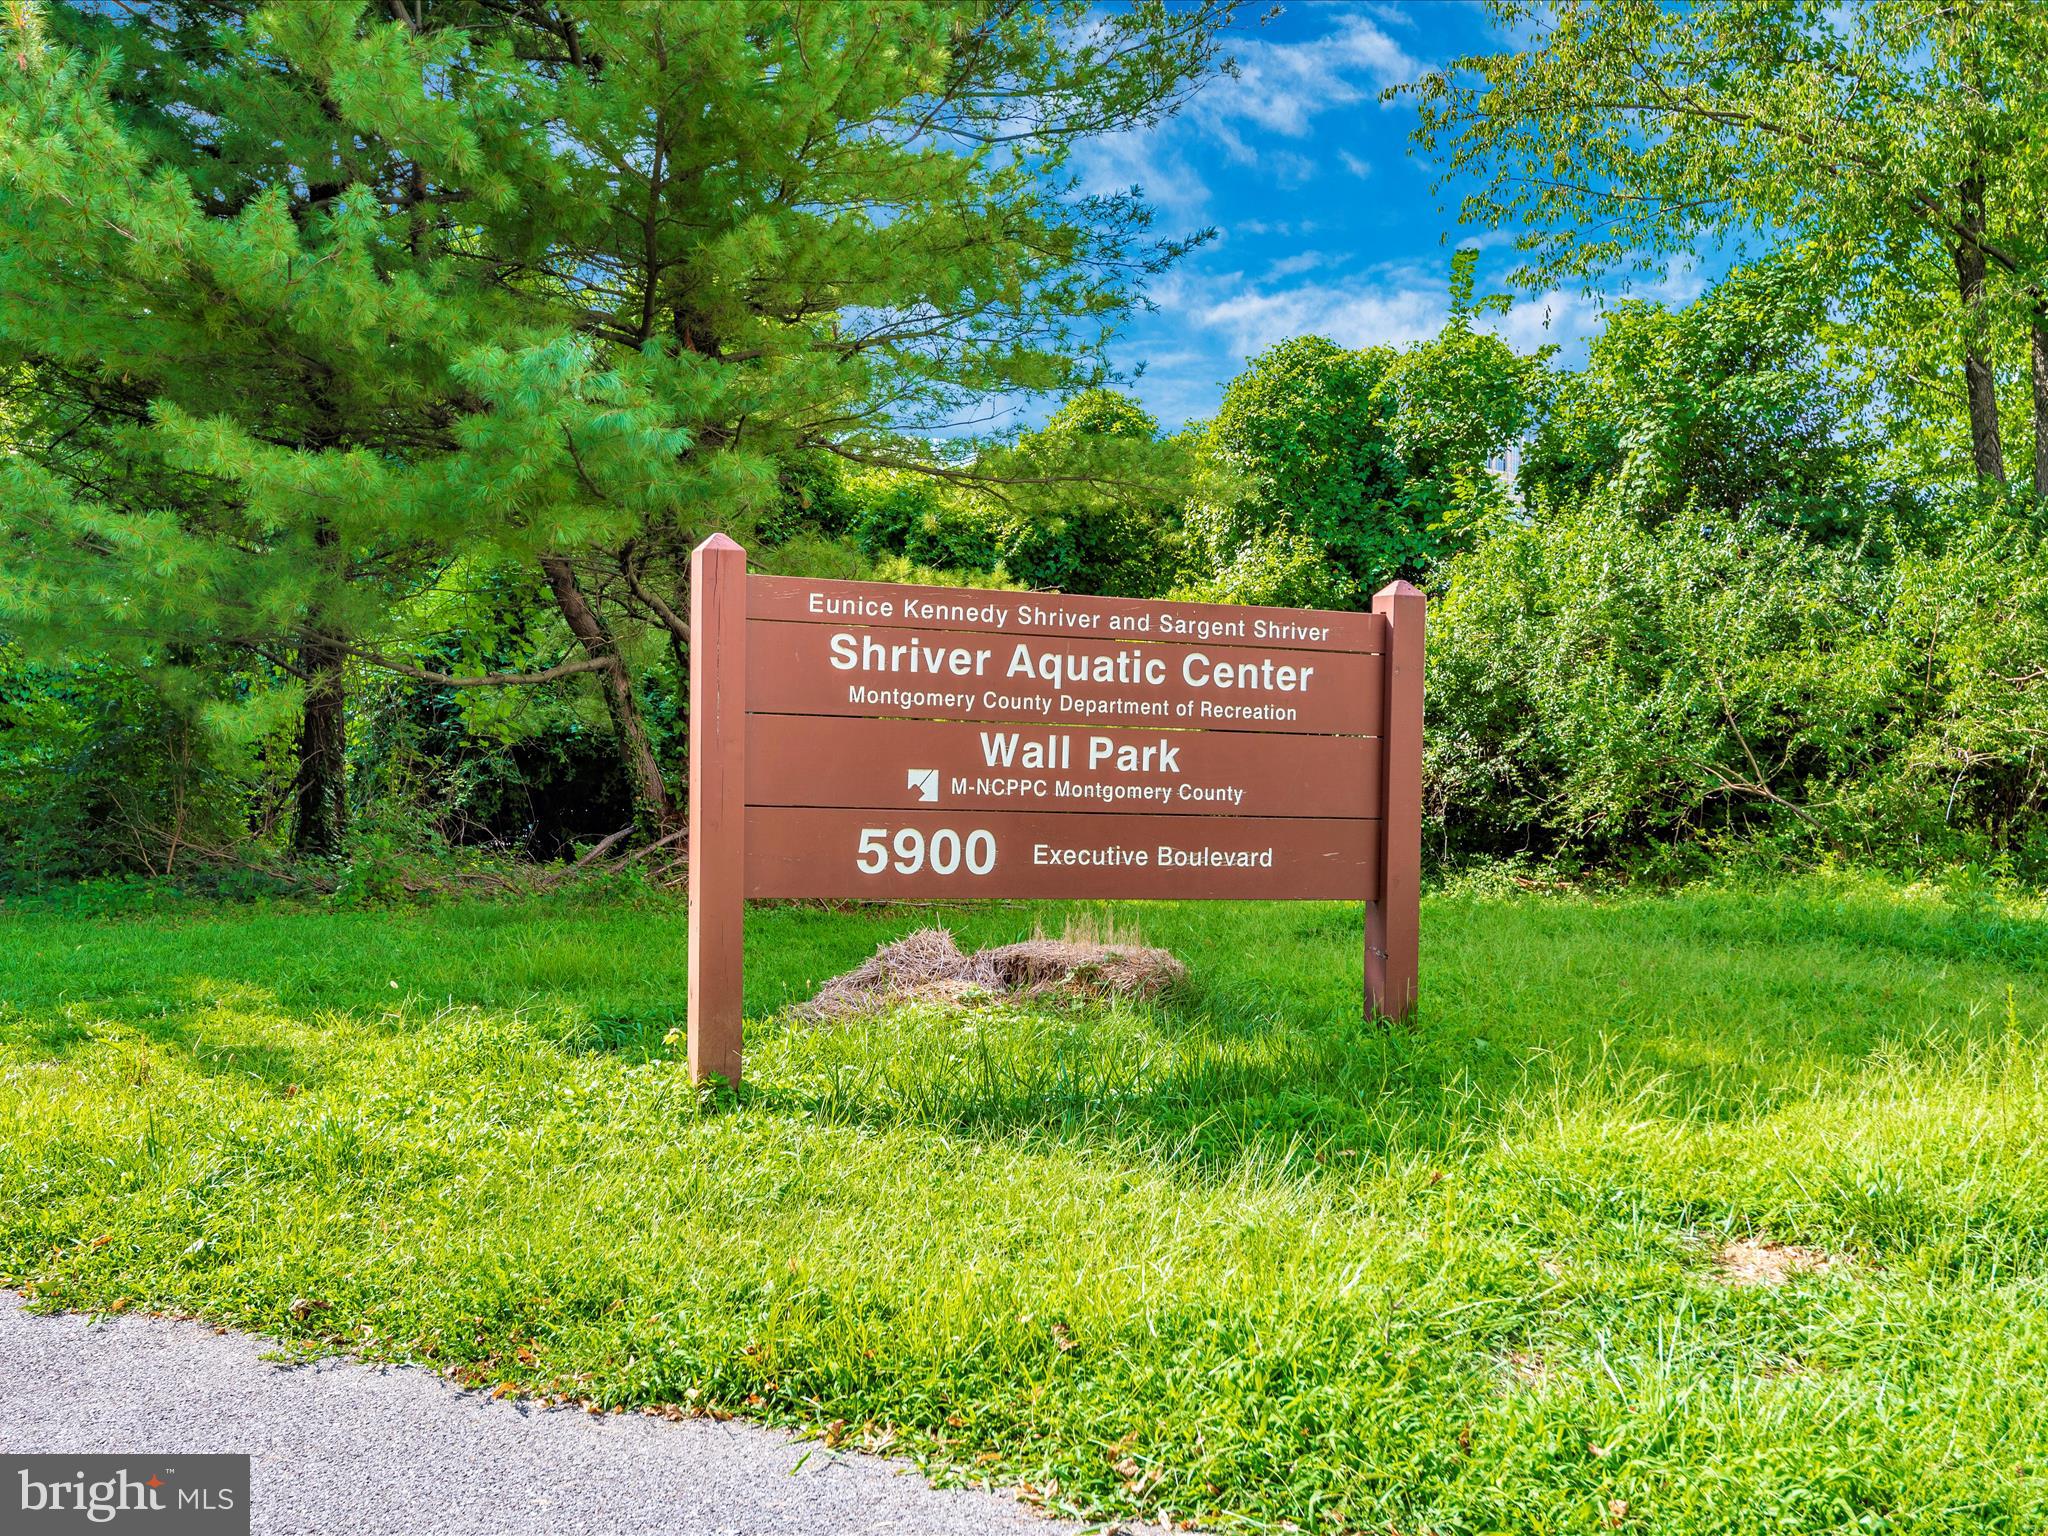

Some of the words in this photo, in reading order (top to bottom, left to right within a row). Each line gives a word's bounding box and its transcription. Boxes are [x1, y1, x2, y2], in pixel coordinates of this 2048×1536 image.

[808, 592, 894, 618] Eunice
[904, 598, 1009, 629] Kennedy
[1017, 605, 1101, 629] Shriver
[1109, 613, 1150, 632] and
[1159, 613, 1246, 640] Sargent
[1253, 619, 1330, 642] Shriver
[829, 632, 992, 676] Shriver
[1006, 643, 1167, 690] Aquatic
[1182, 652, 1315, 692] Center
[848, 685, 976, 712] Montgomery
[983, 690, 1053, 716] County
[1059, 694, 1170, 718] Department
[1175, 699, 1195, 717] of
[1200, 700, 1298, 721] Recreation
[979, 731, 1070, 769] Wall
[1088, 735, 1180, 774] Park
[950, 777, 1047, 797] M-NCPPC
[1054, 780, 1173, 806] Montgomery
[1178, 783, 1244, 805] County
[856, 827, 997, 875] 5900
[1033, 844, 1149, 867] Executive
[1157, 846, 1273, 868] Boulevard
